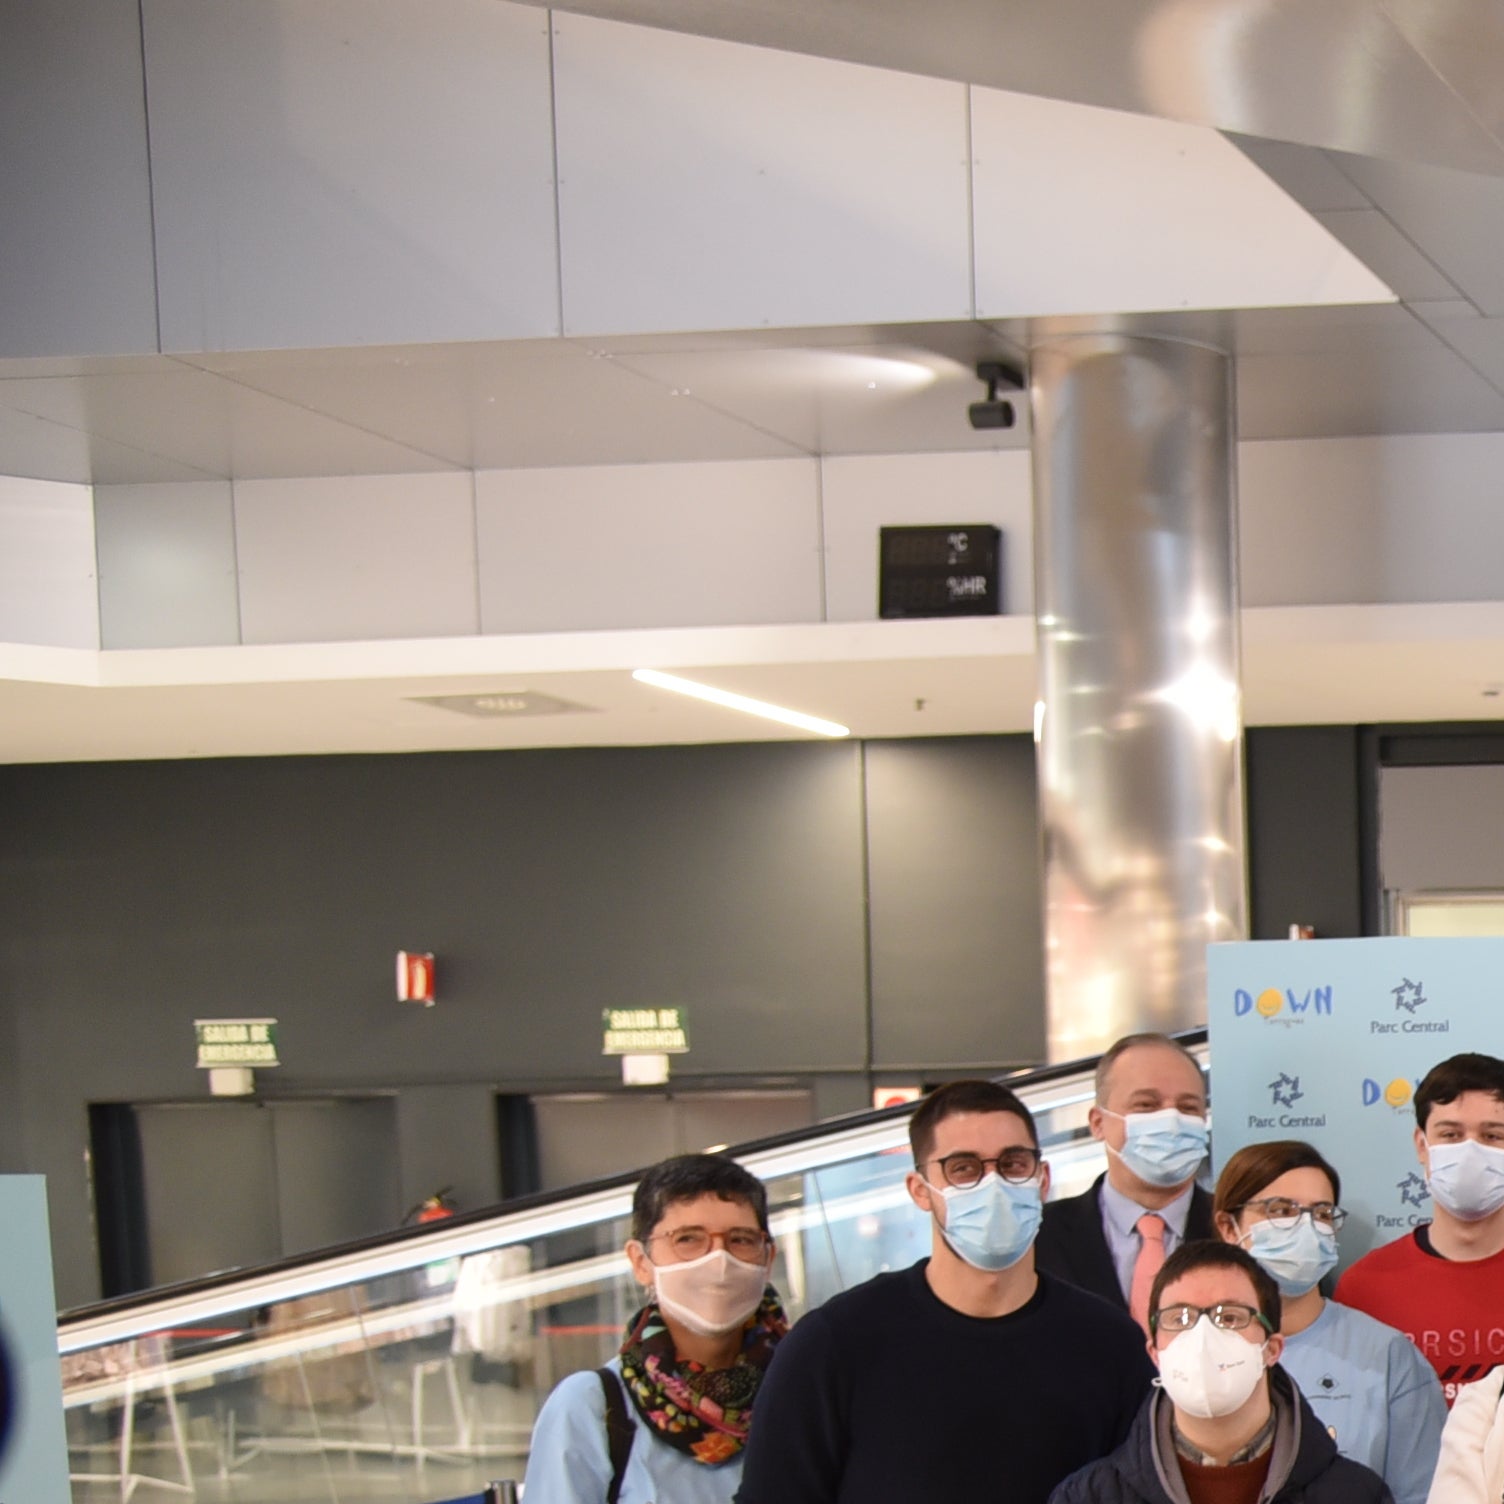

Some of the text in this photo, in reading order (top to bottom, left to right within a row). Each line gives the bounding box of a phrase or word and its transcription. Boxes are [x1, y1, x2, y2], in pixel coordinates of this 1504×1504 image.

[1234, 985, 1332, 1018] DOWN
[1370, 1020, 1450, 1034] Parc Central
[1362, 1078, 1422, 1108] DO
[1249, 1114, 1327, 1129] Parc Central
[1376, 1215, 1404, 1228] Parc
